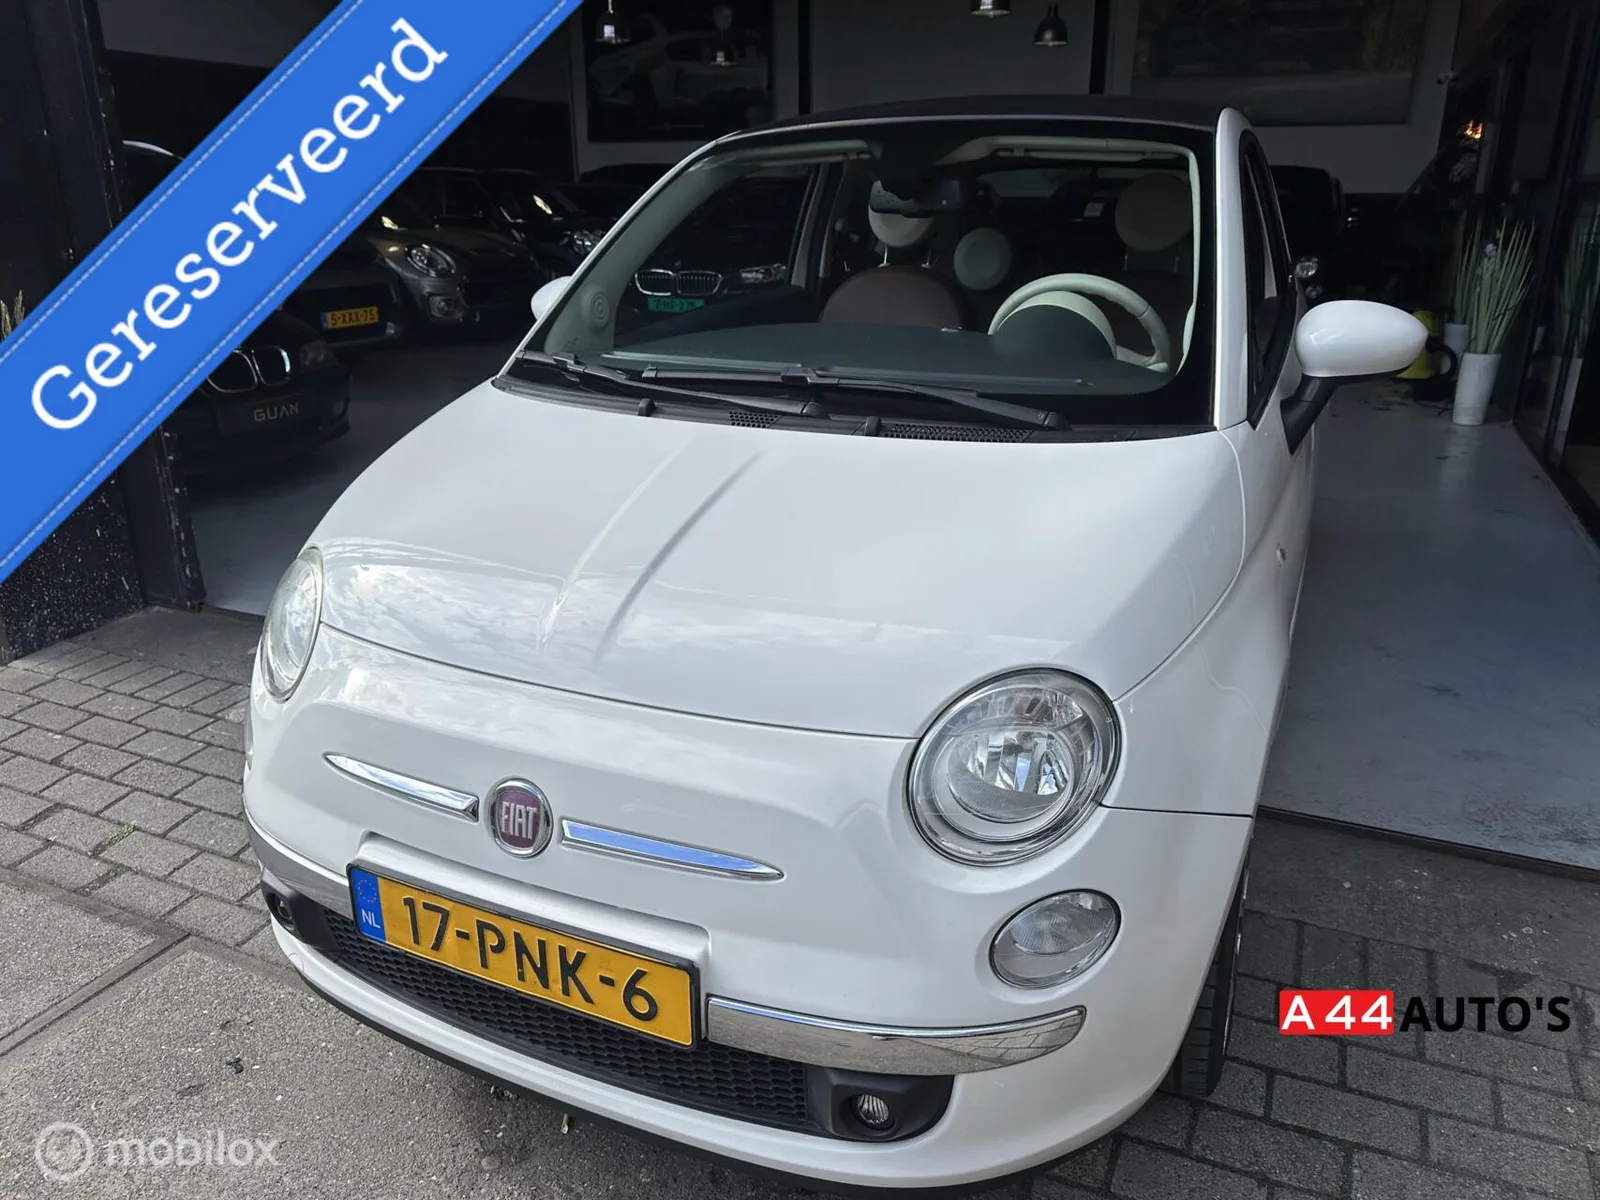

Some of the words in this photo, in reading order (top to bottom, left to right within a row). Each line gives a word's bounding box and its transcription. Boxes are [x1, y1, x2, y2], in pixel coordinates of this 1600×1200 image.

[501, 801, 538, 840] FIAT
[361, 908, 381, 929] NL
[402, 895, 659, 1022] 17-PNK-6
